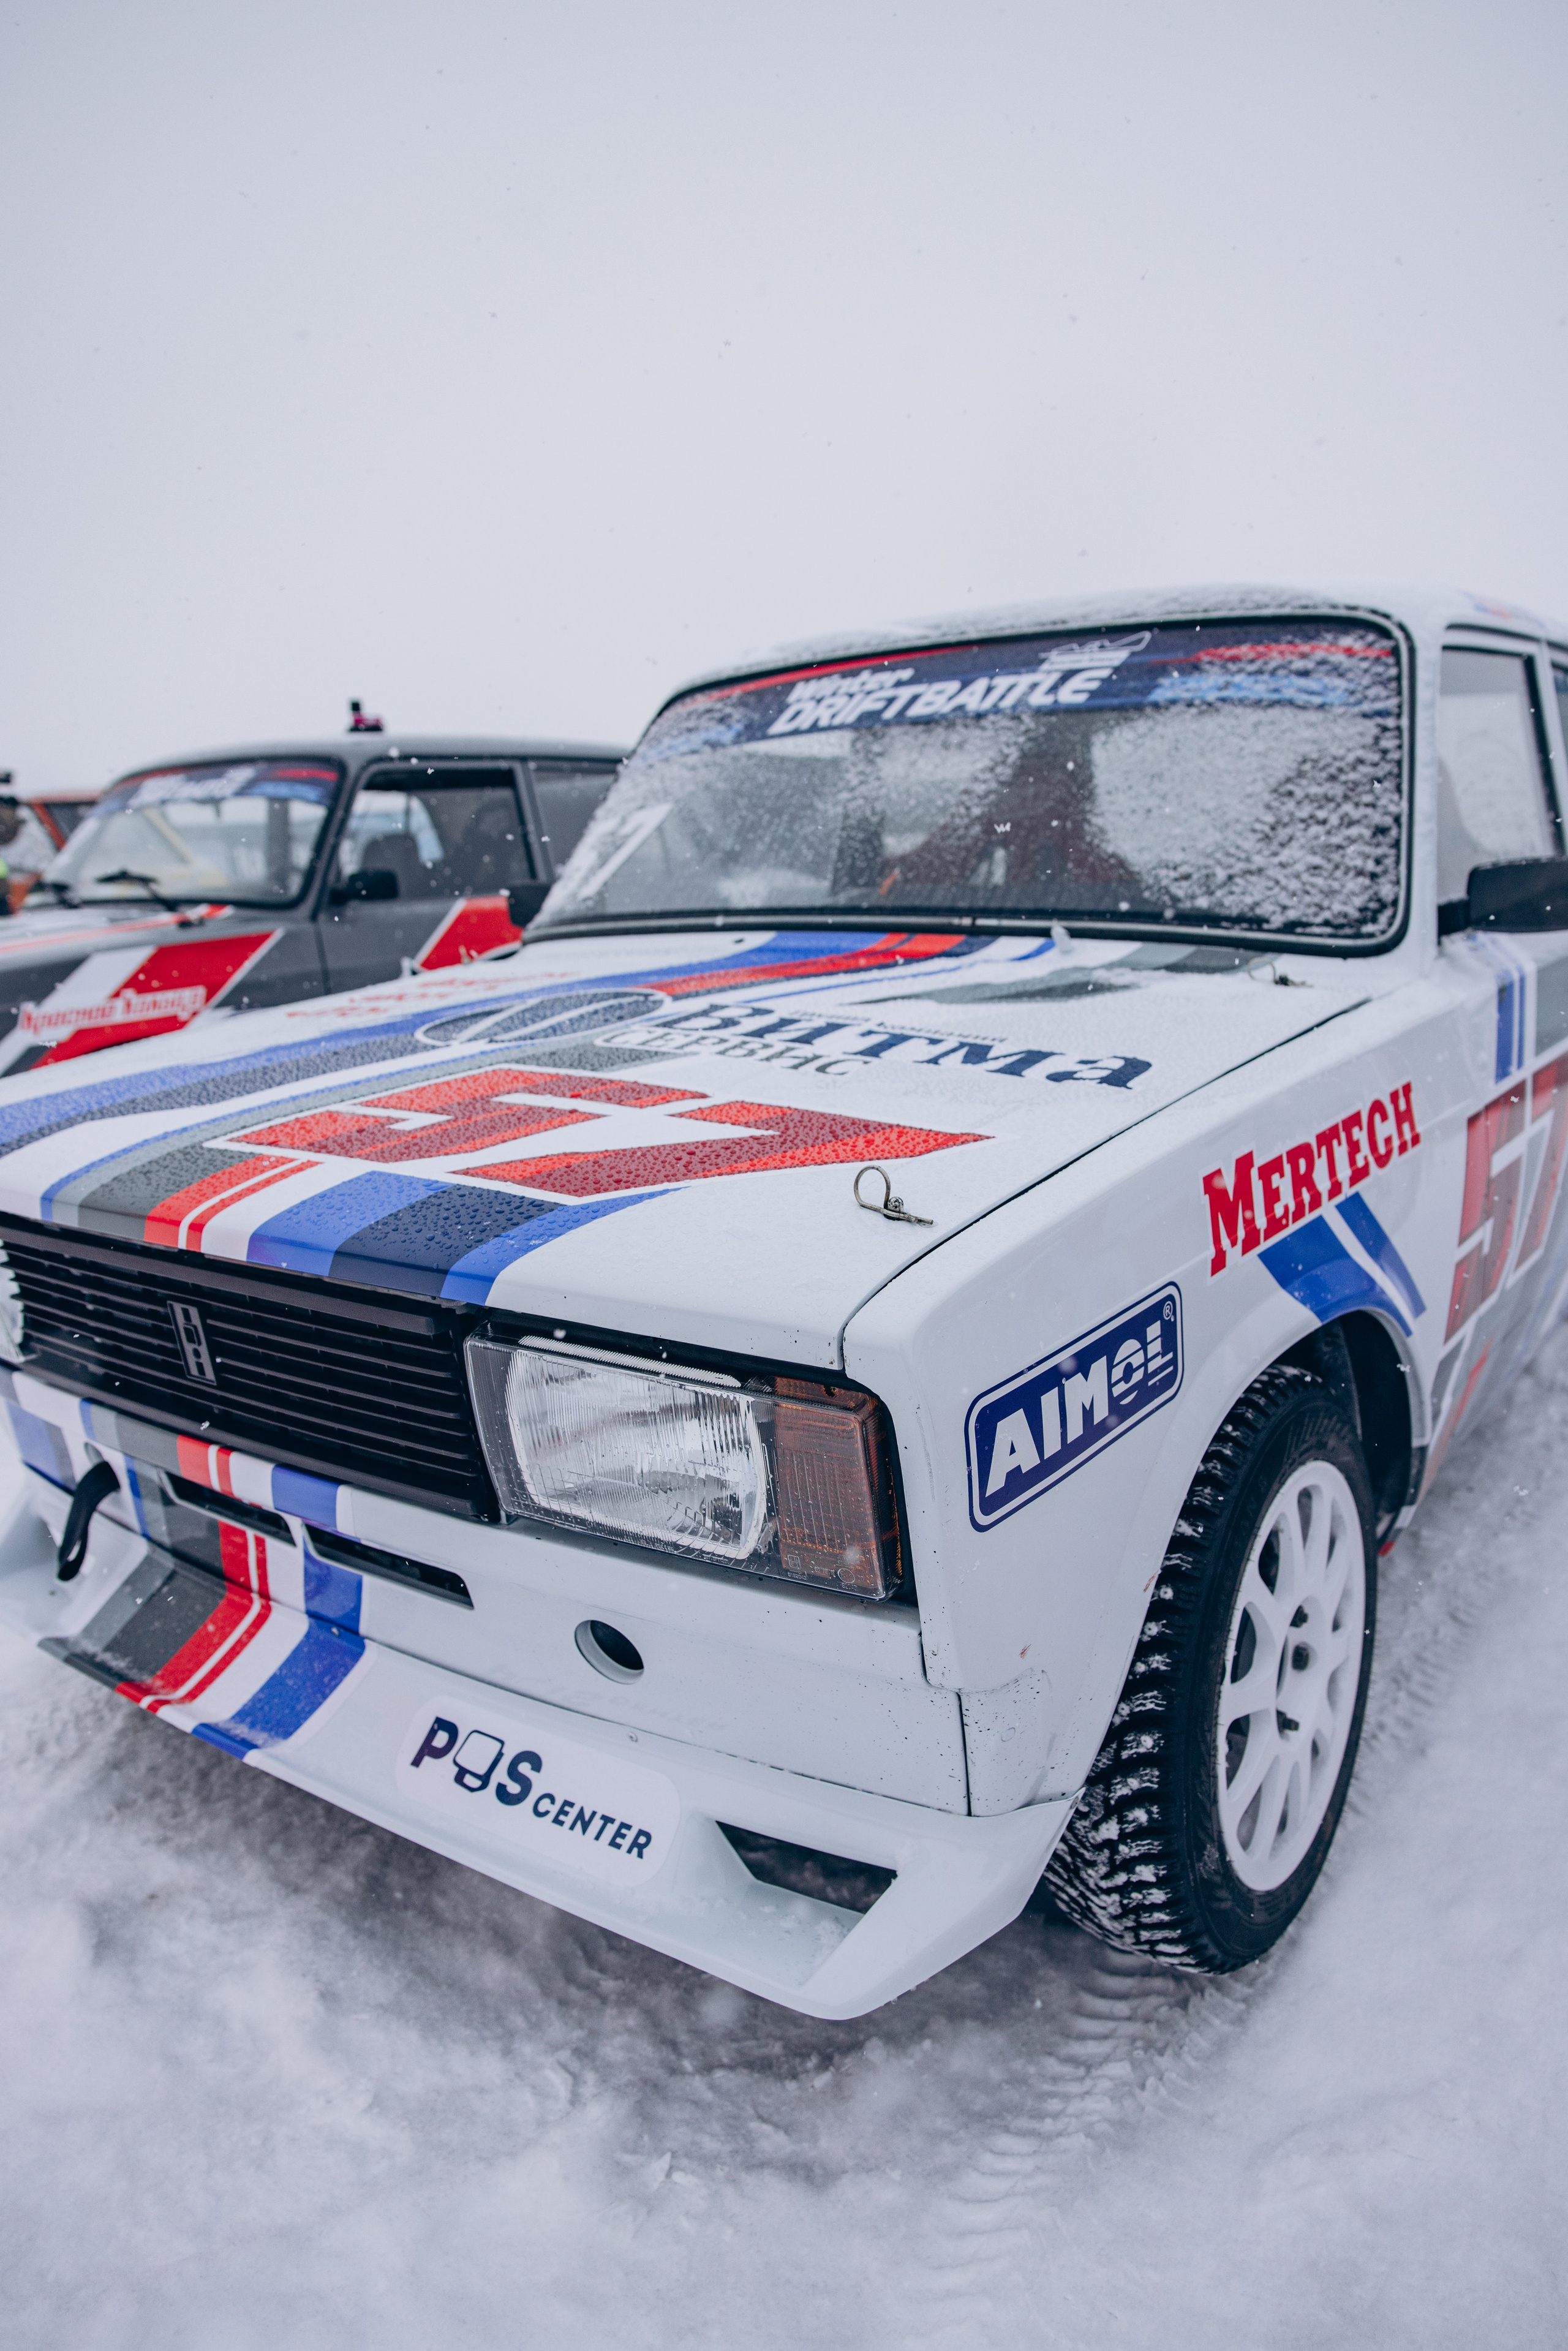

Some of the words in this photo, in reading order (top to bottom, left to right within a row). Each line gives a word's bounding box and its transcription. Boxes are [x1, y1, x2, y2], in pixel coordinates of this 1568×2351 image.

[767, 667, 1114, 735] DRIFTBATTLE
[602, 1031, 871, 1076] СЕРВИС
[227, 1068, 997, 1197] 57
